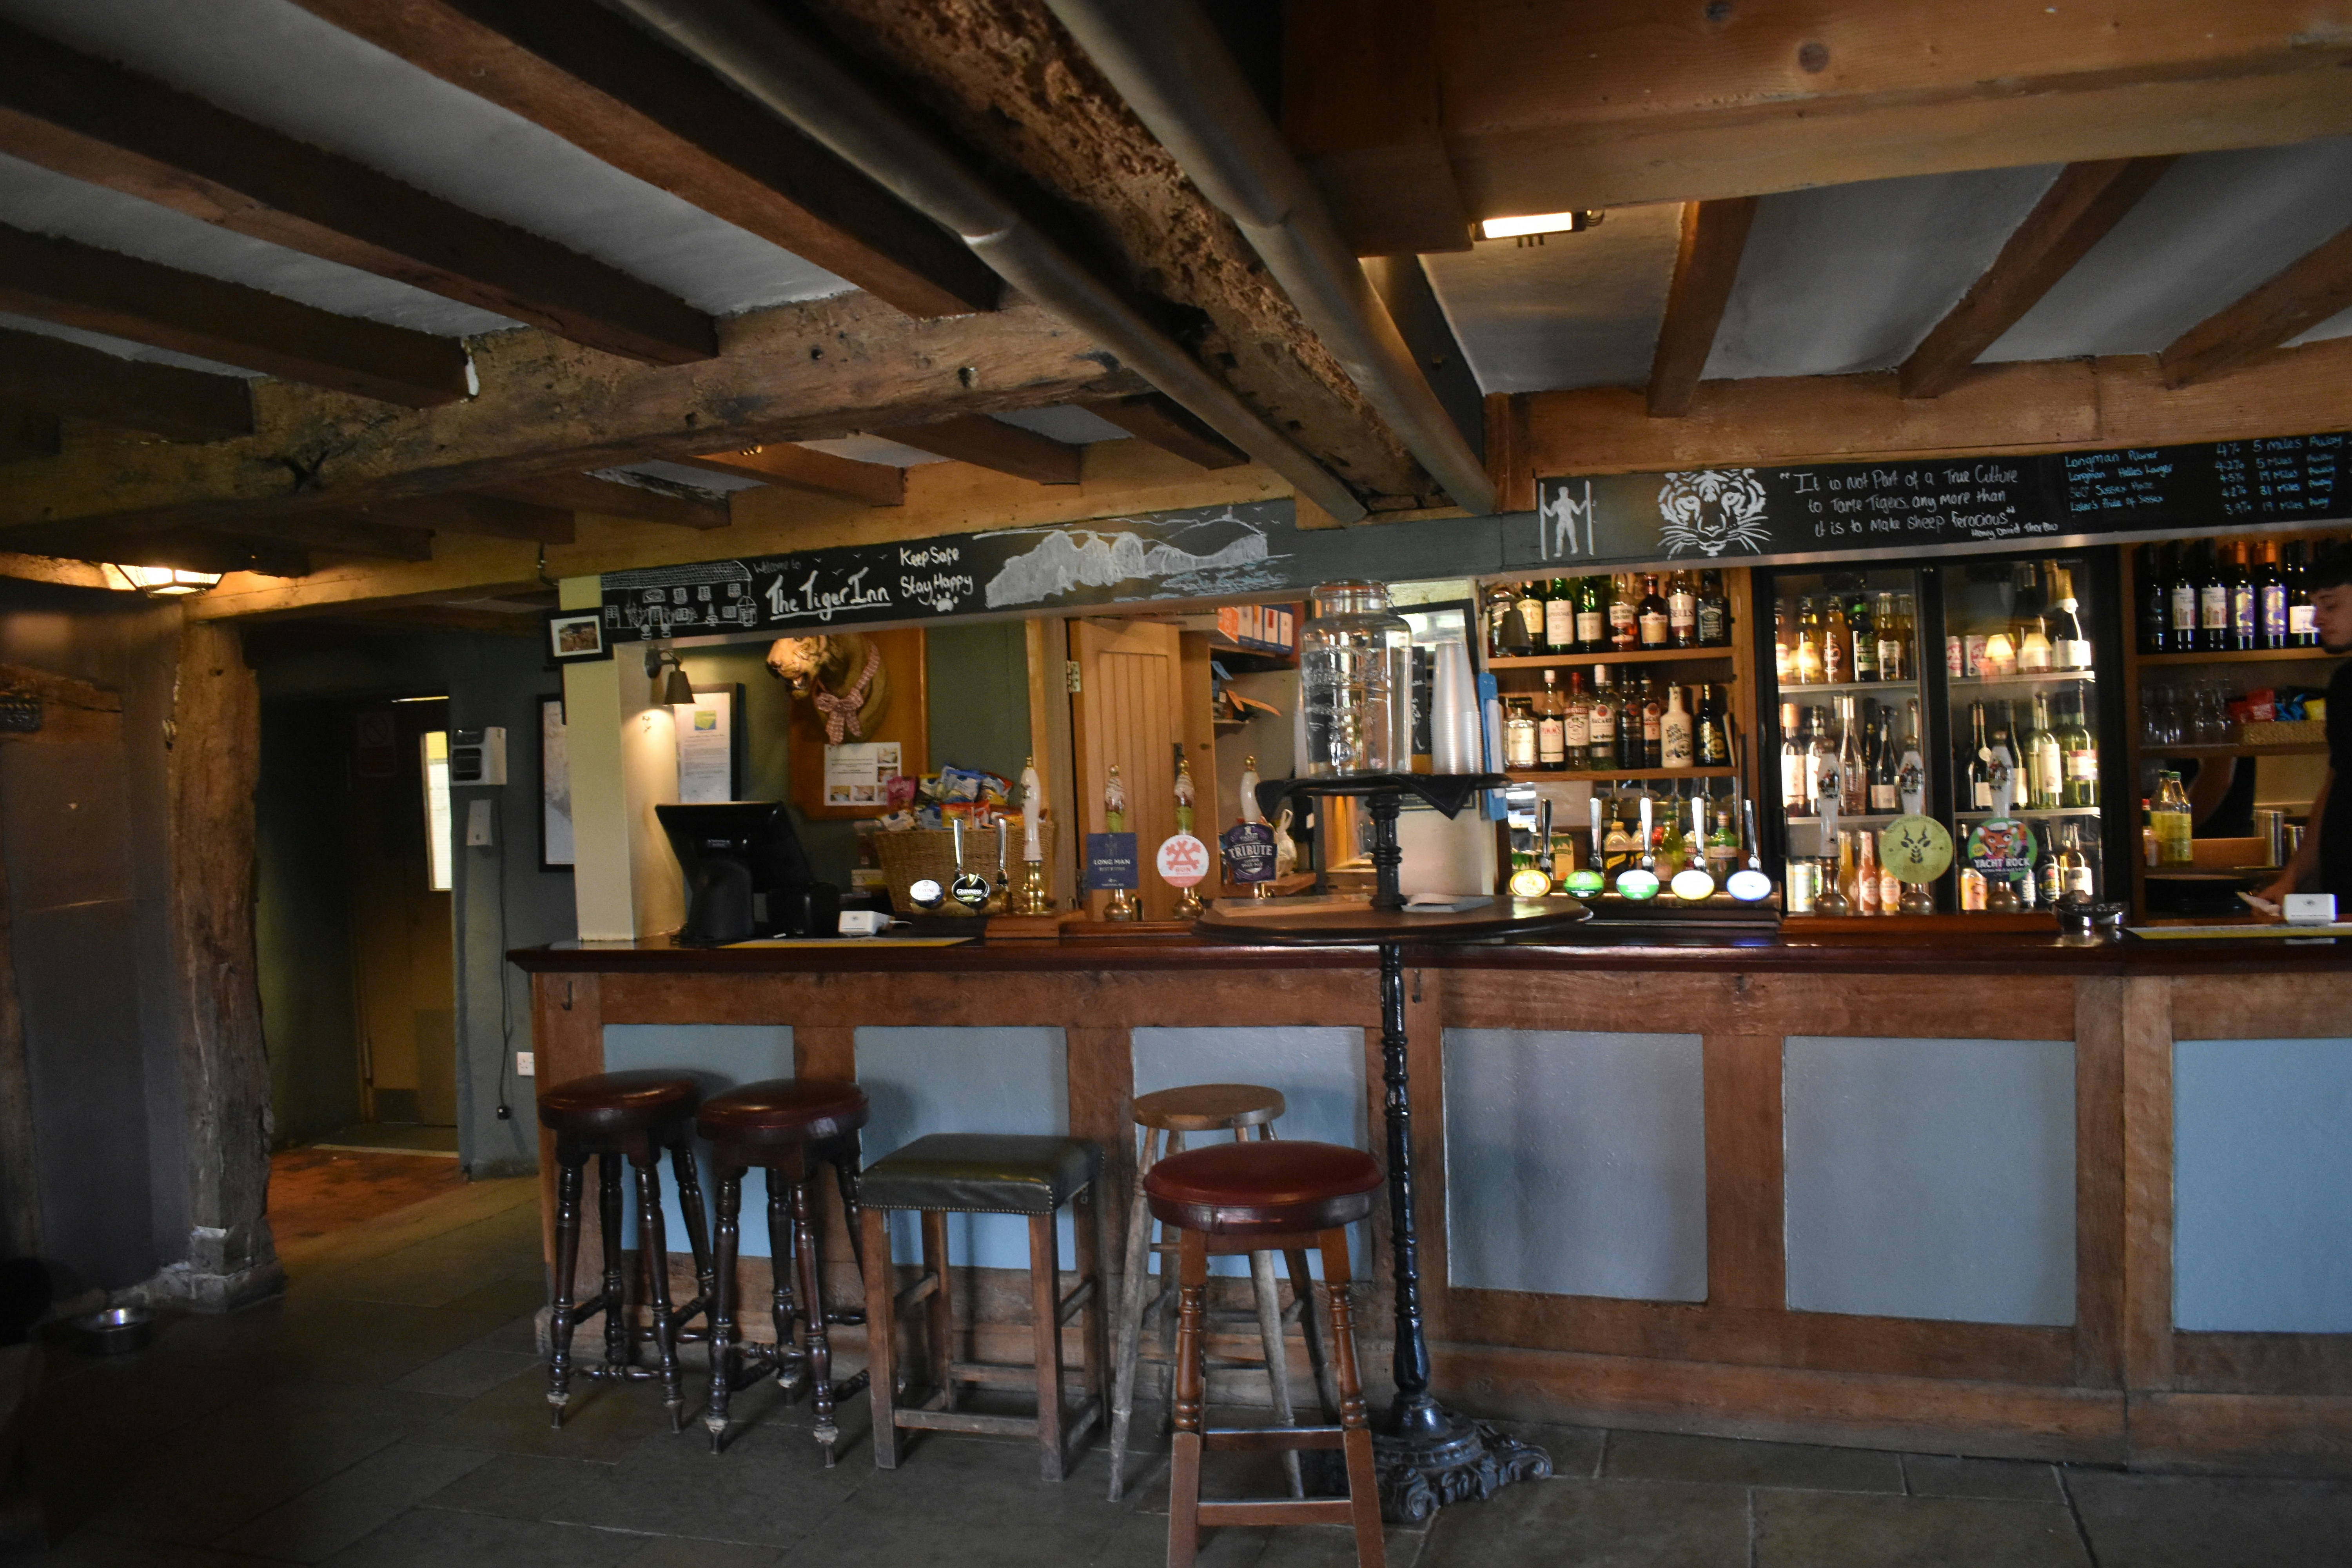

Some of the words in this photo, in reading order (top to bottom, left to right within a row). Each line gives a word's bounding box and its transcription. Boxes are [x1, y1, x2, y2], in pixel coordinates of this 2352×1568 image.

[2065, 454, 2120, 472] Longman
[1826, 476, 1842, 490] is
[1905, 470, 1919, 490] of
[1925, 472, 1935, 485] a
[1808, 499, 1822, 513] to
[1912, 496, 1937, 513] any
[1976, 488, 2006, 503] than
[1830, 521, 1844, 535] is
[900, 547, 929, 568] Keep
[930, 546, 959, 566] Safe
[765, 574, 799, 614] The
[799, 570, 849, 621] Tiger
[848, 566, 890, 604] Inn
[900, 575, 933, 606] Stay
[933, 573, 974, 595] Happy
[1227, 844, 1272, 859] TRIBUTE
[1973, 859, 2003, 868] YACHT
[2005, 858, 2030, 867] ROCK
